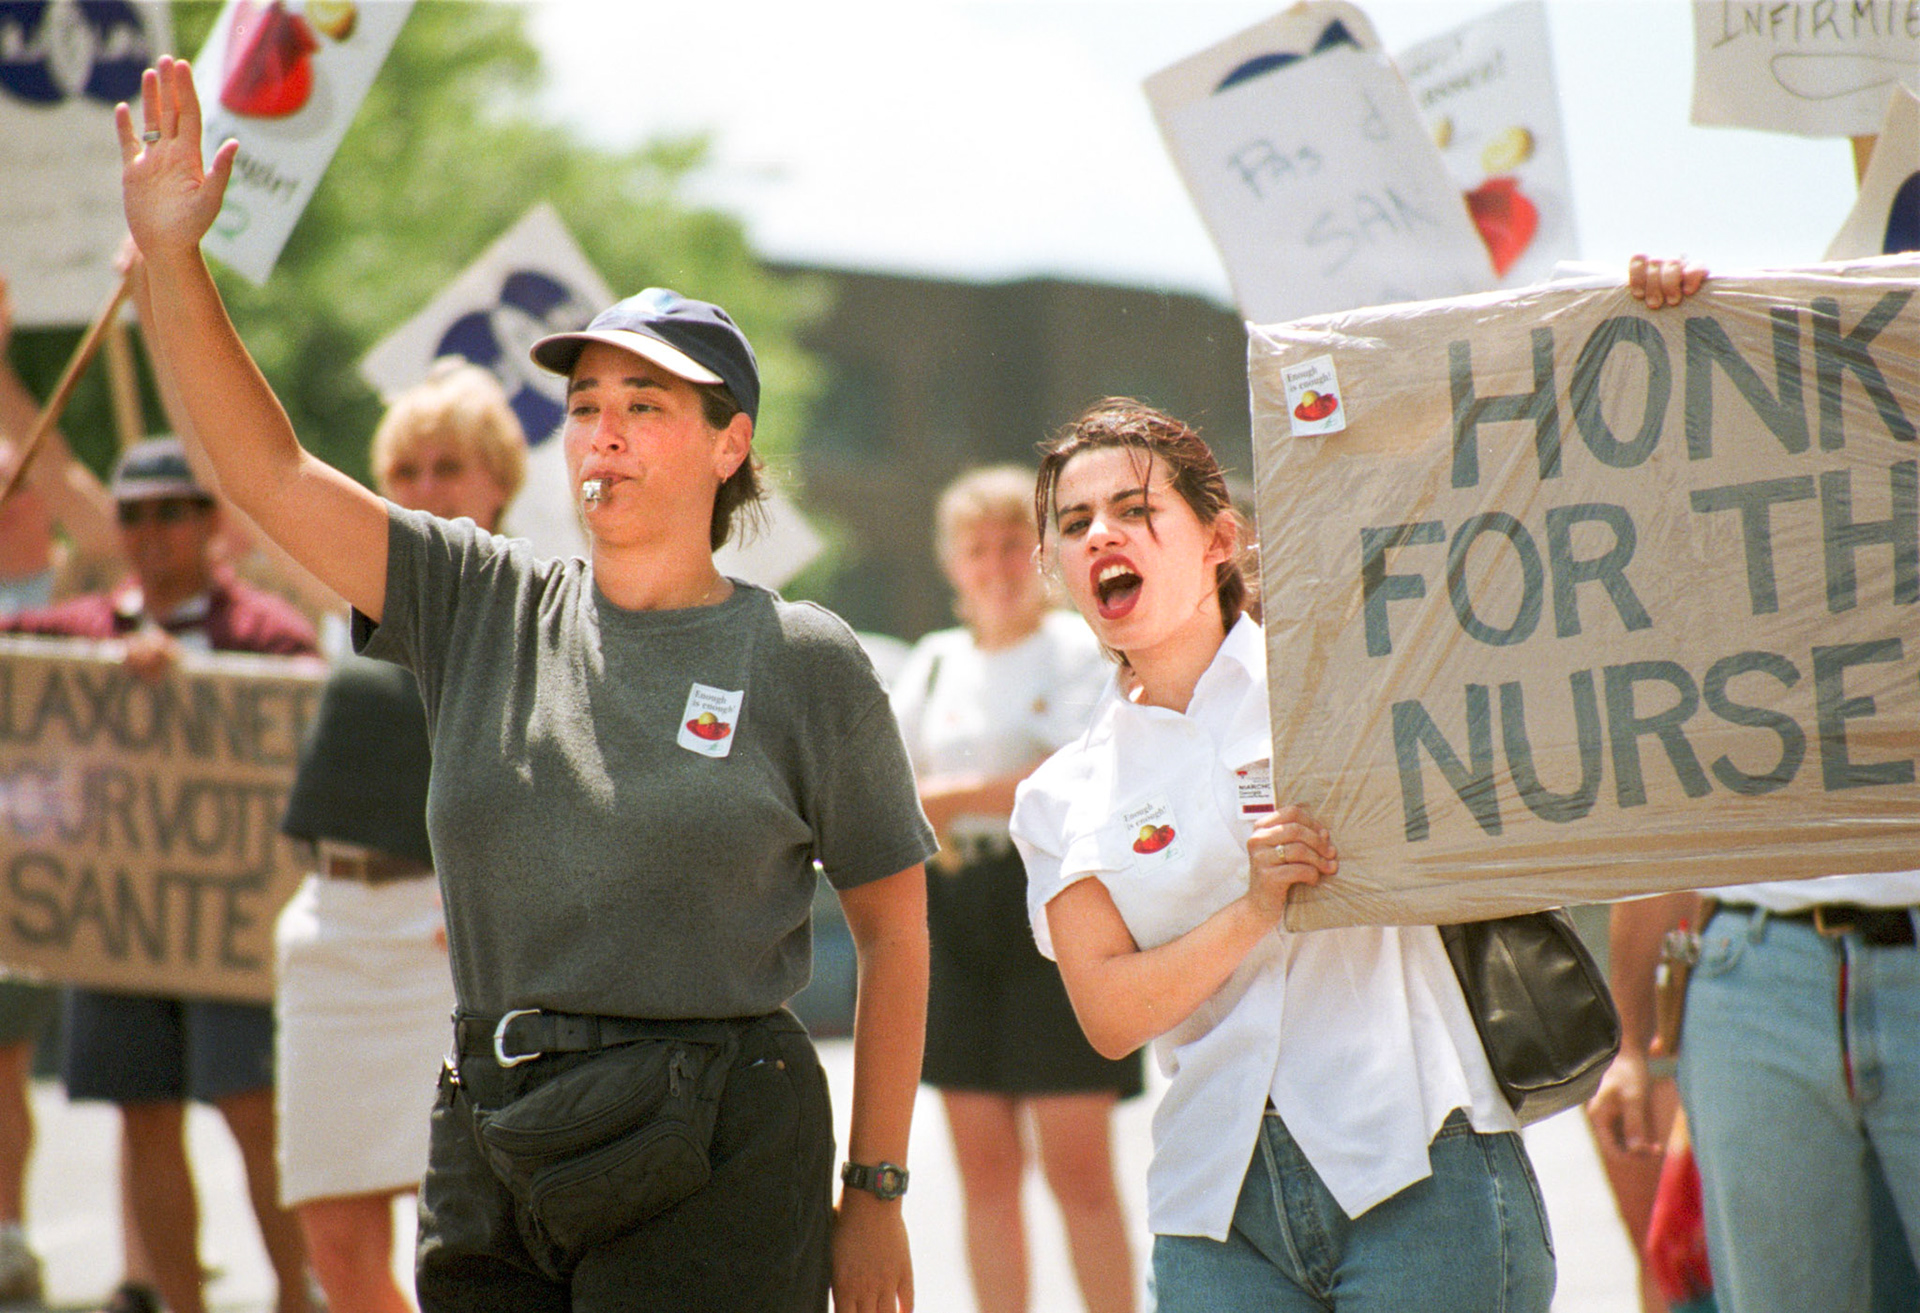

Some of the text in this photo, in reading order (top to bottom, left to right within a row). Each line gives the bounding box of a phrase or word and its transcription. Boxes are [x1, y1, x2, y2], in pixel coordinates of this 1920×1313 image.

[1287, 366, 1318, 382] Enough
[1448, 289, 1918, 489] HONK
[1361, 502, 1653, 658] FOR
[694, 689, 727, 705] Enough
[1391, 637, 1917, 843] NURSE
[1123, 802, 1153, 822] Enough
